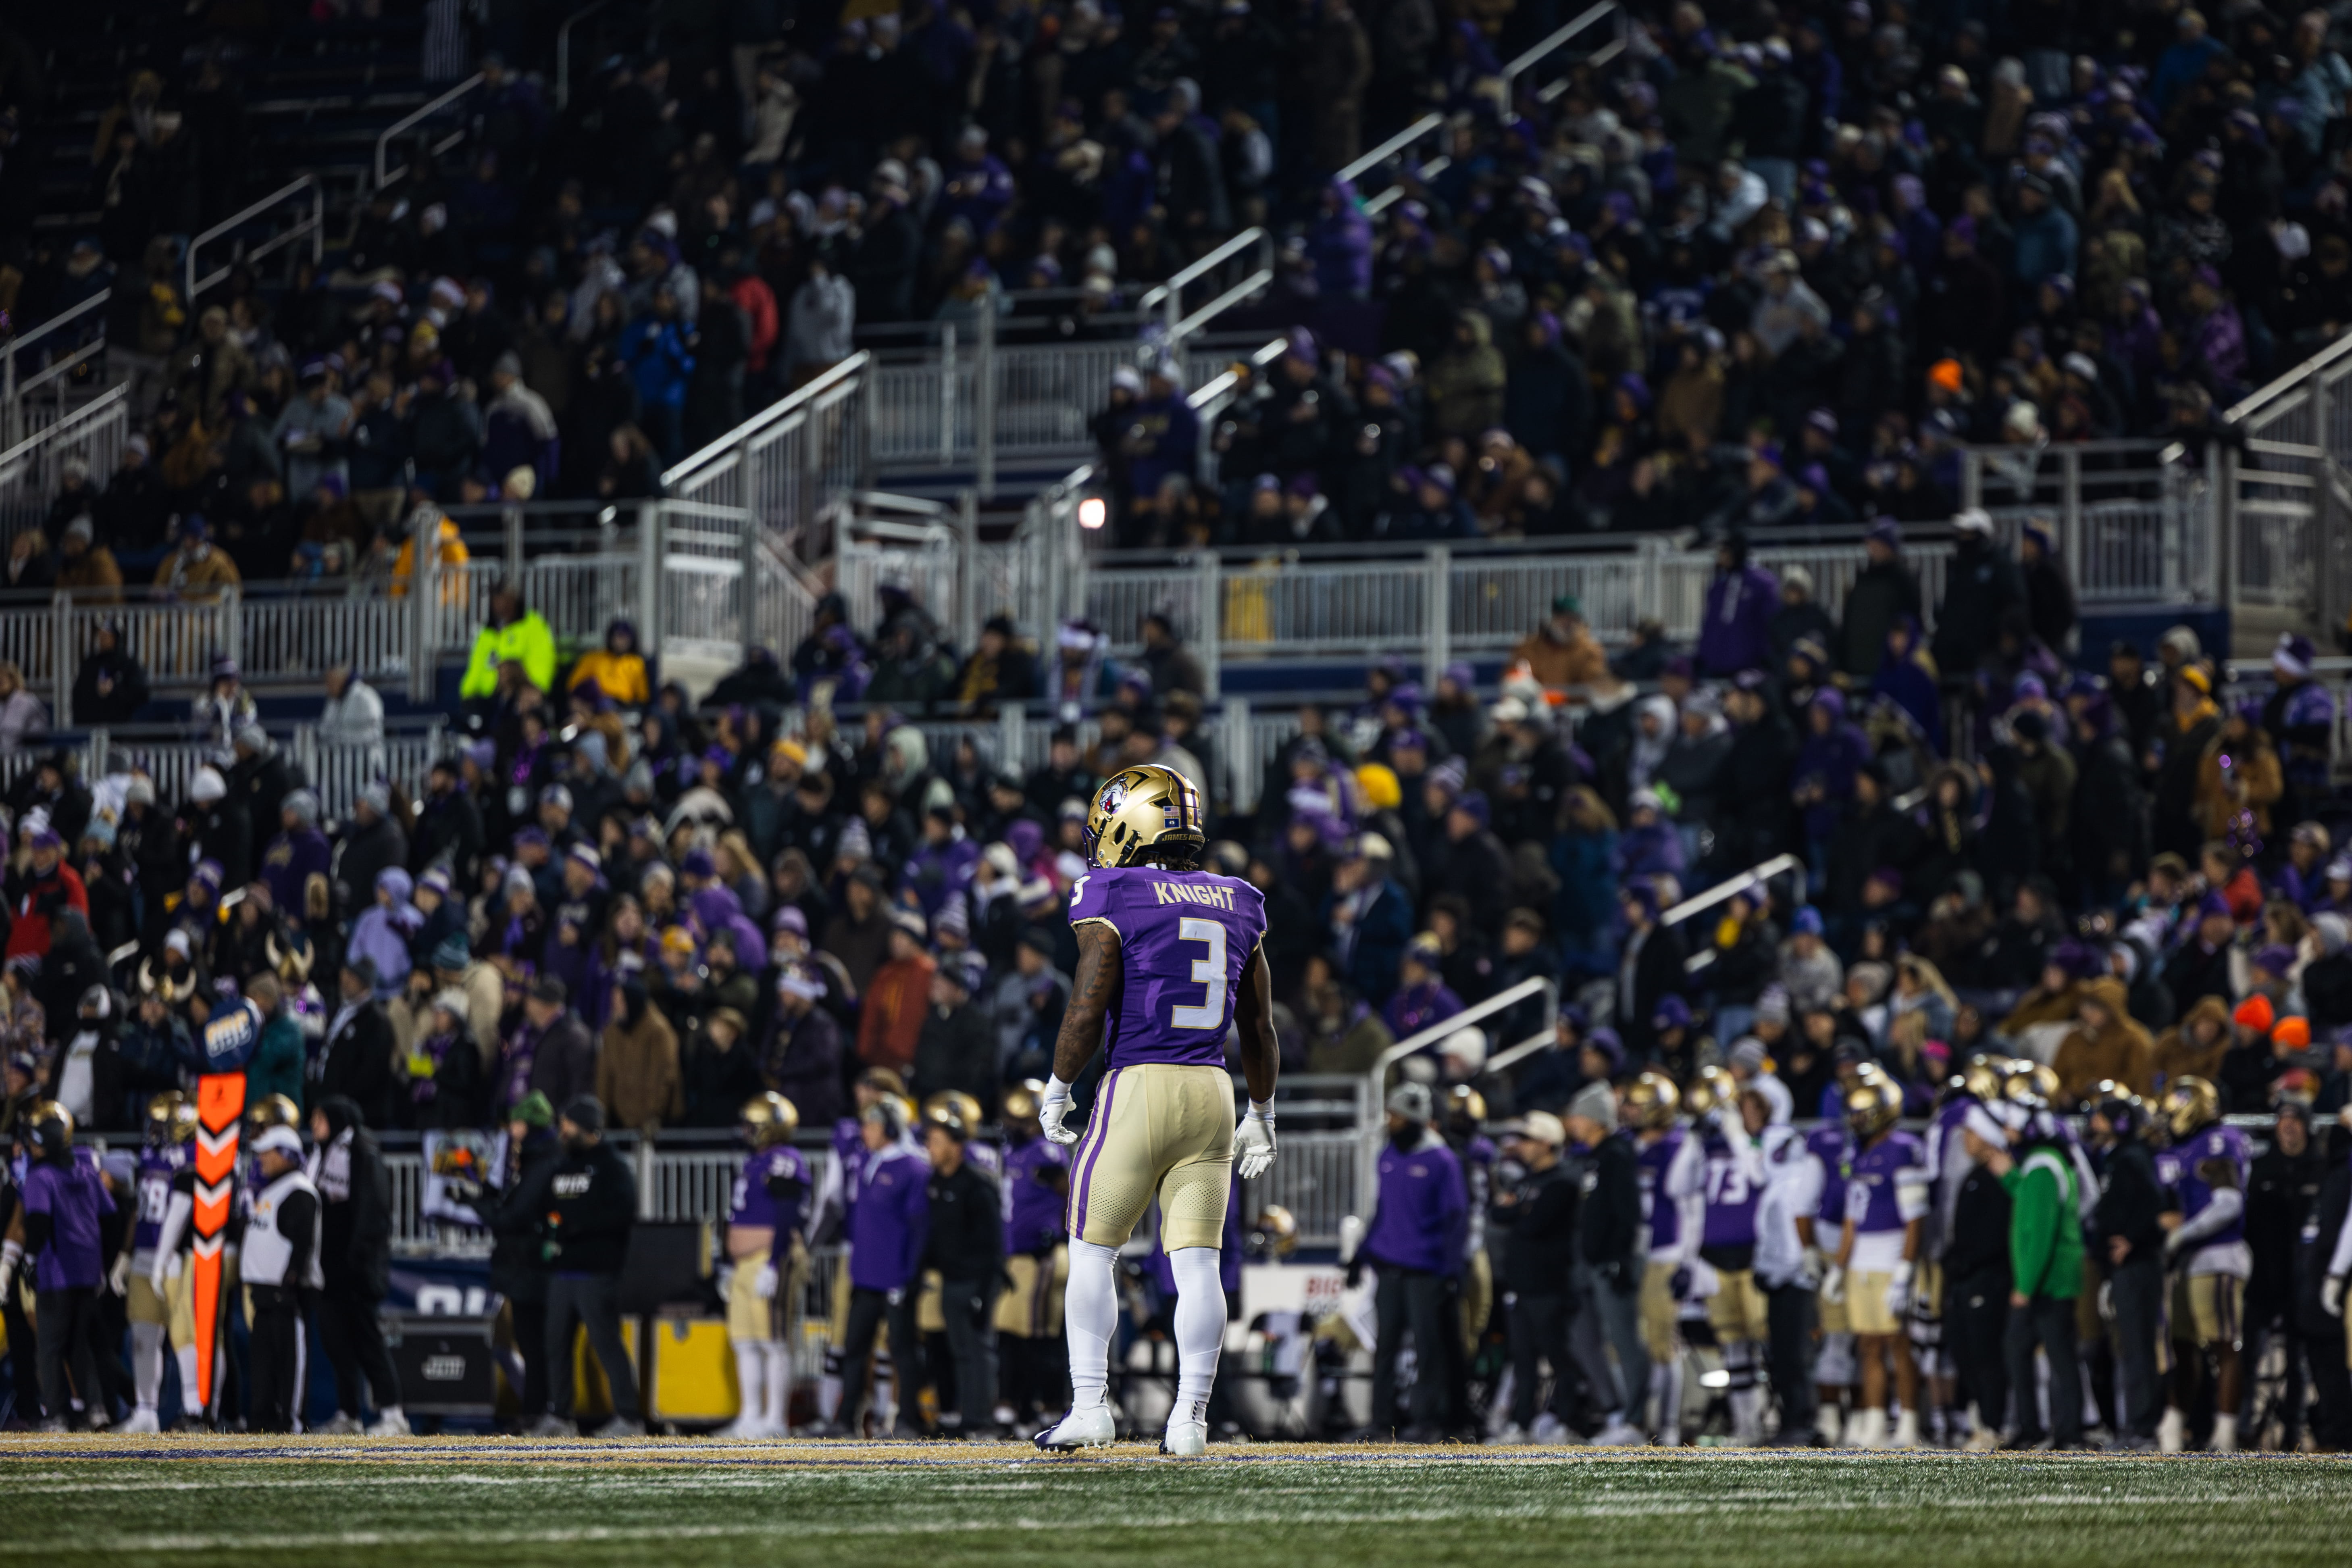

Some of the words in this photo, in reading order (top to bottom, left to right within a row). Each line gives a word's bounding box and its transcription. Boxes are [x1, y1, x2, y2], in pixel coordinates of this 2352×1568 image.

[1070, 875, 1091, 907] 3
[1153, 882, 1234, 911] KNIGHT
[1171, 917, 1228, 1029] 3
